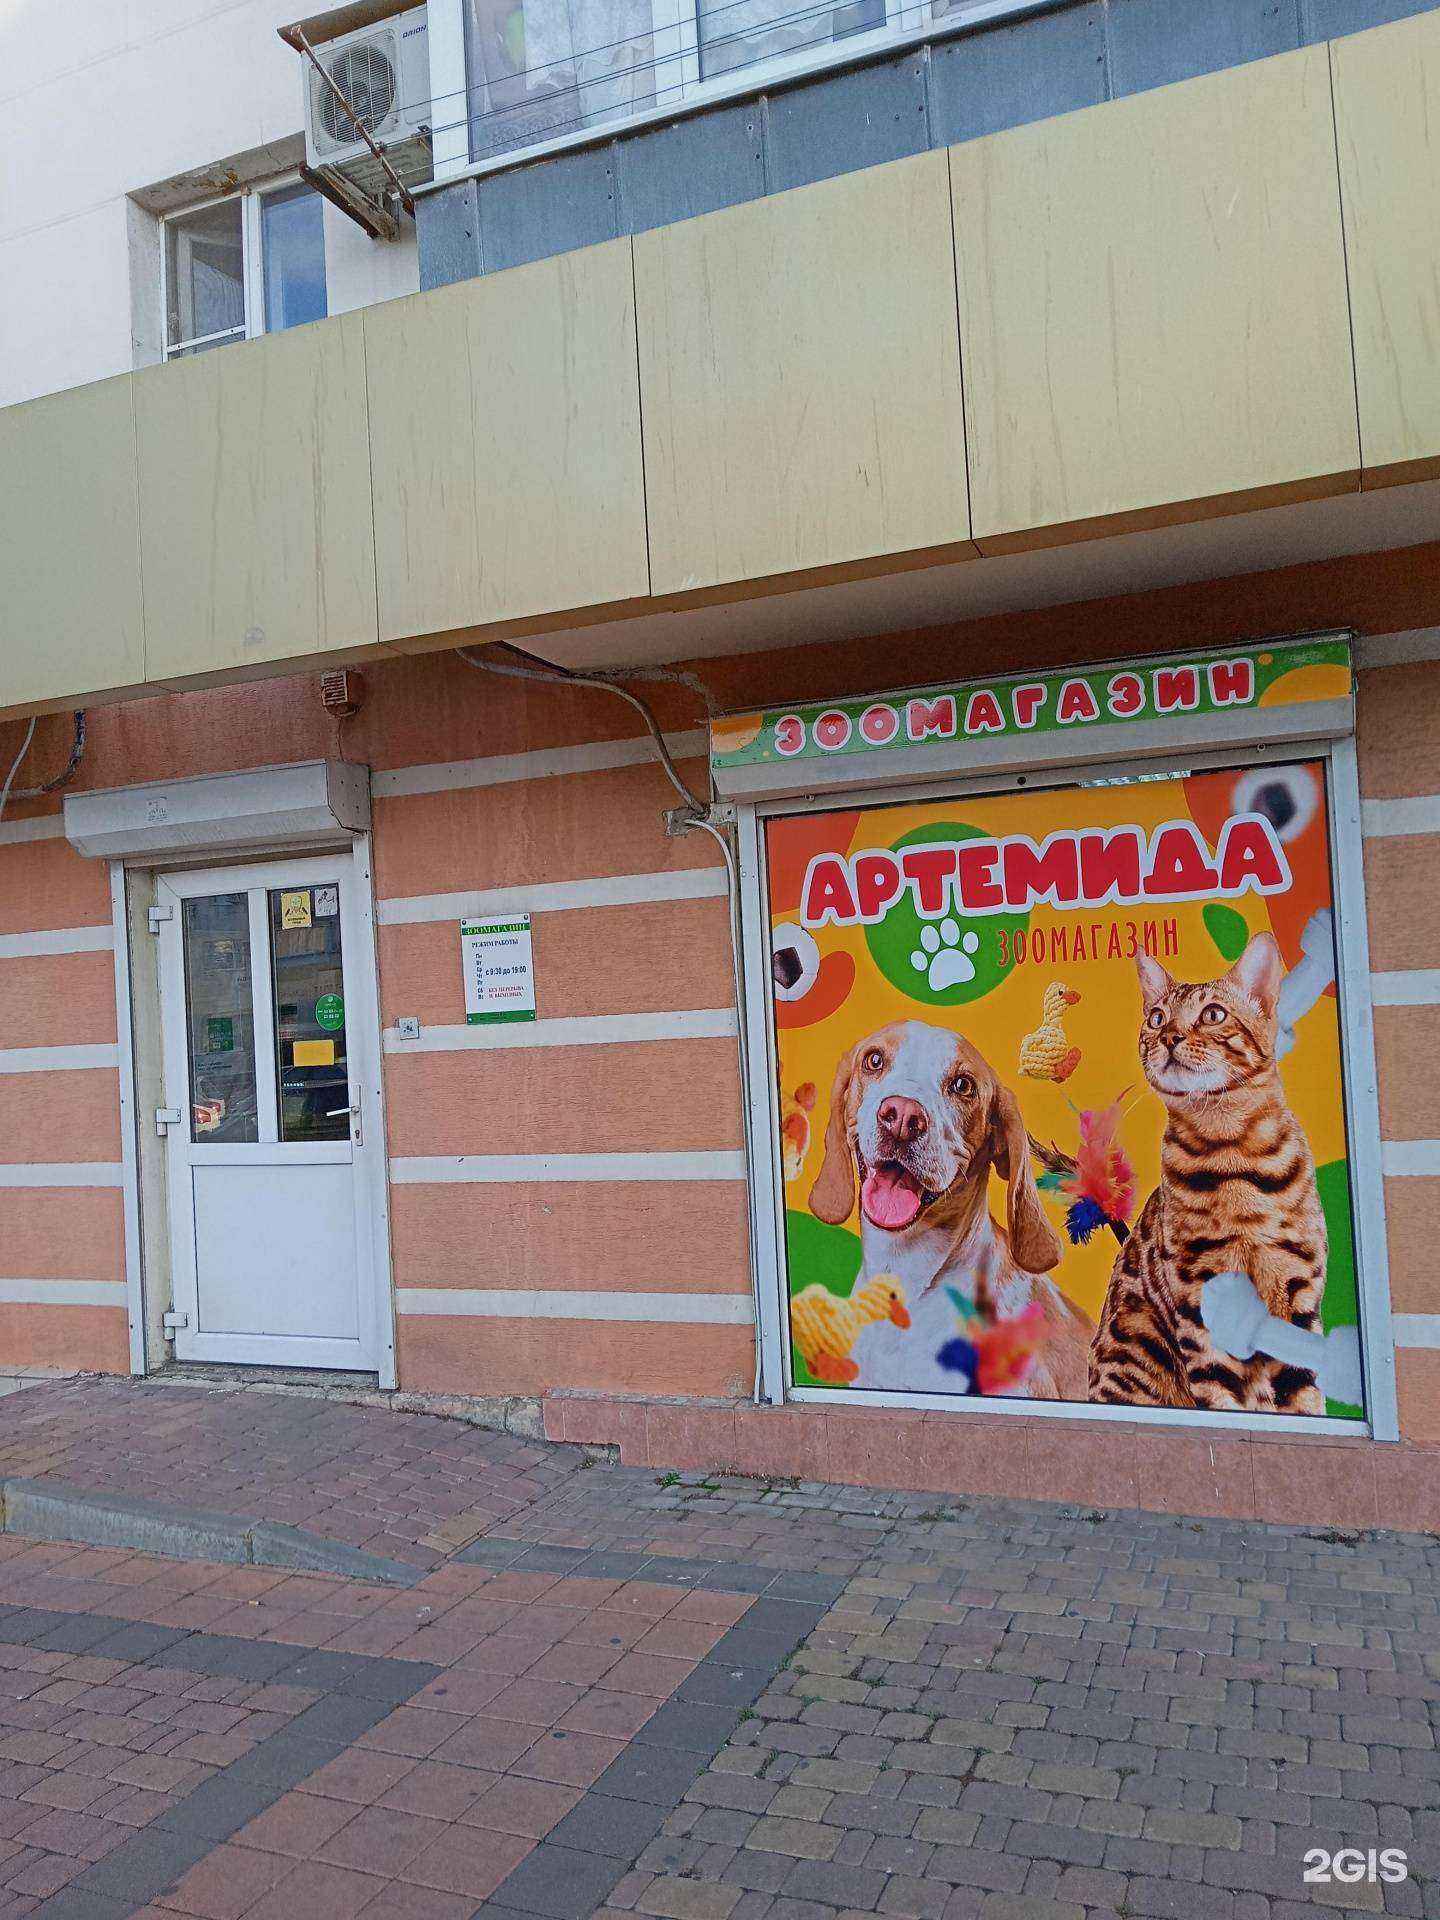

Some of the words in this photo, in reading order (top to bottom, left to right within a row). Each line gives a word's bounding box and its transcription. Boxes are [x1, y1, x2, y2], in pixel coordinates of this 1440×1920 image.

[773, 657, 1255, 756] ЗООМАГАЗИН
[801, 811, 1293, 929] АРТЕМИДА
[997, 917, 1180, 967] ЗООМАГАЗИН
